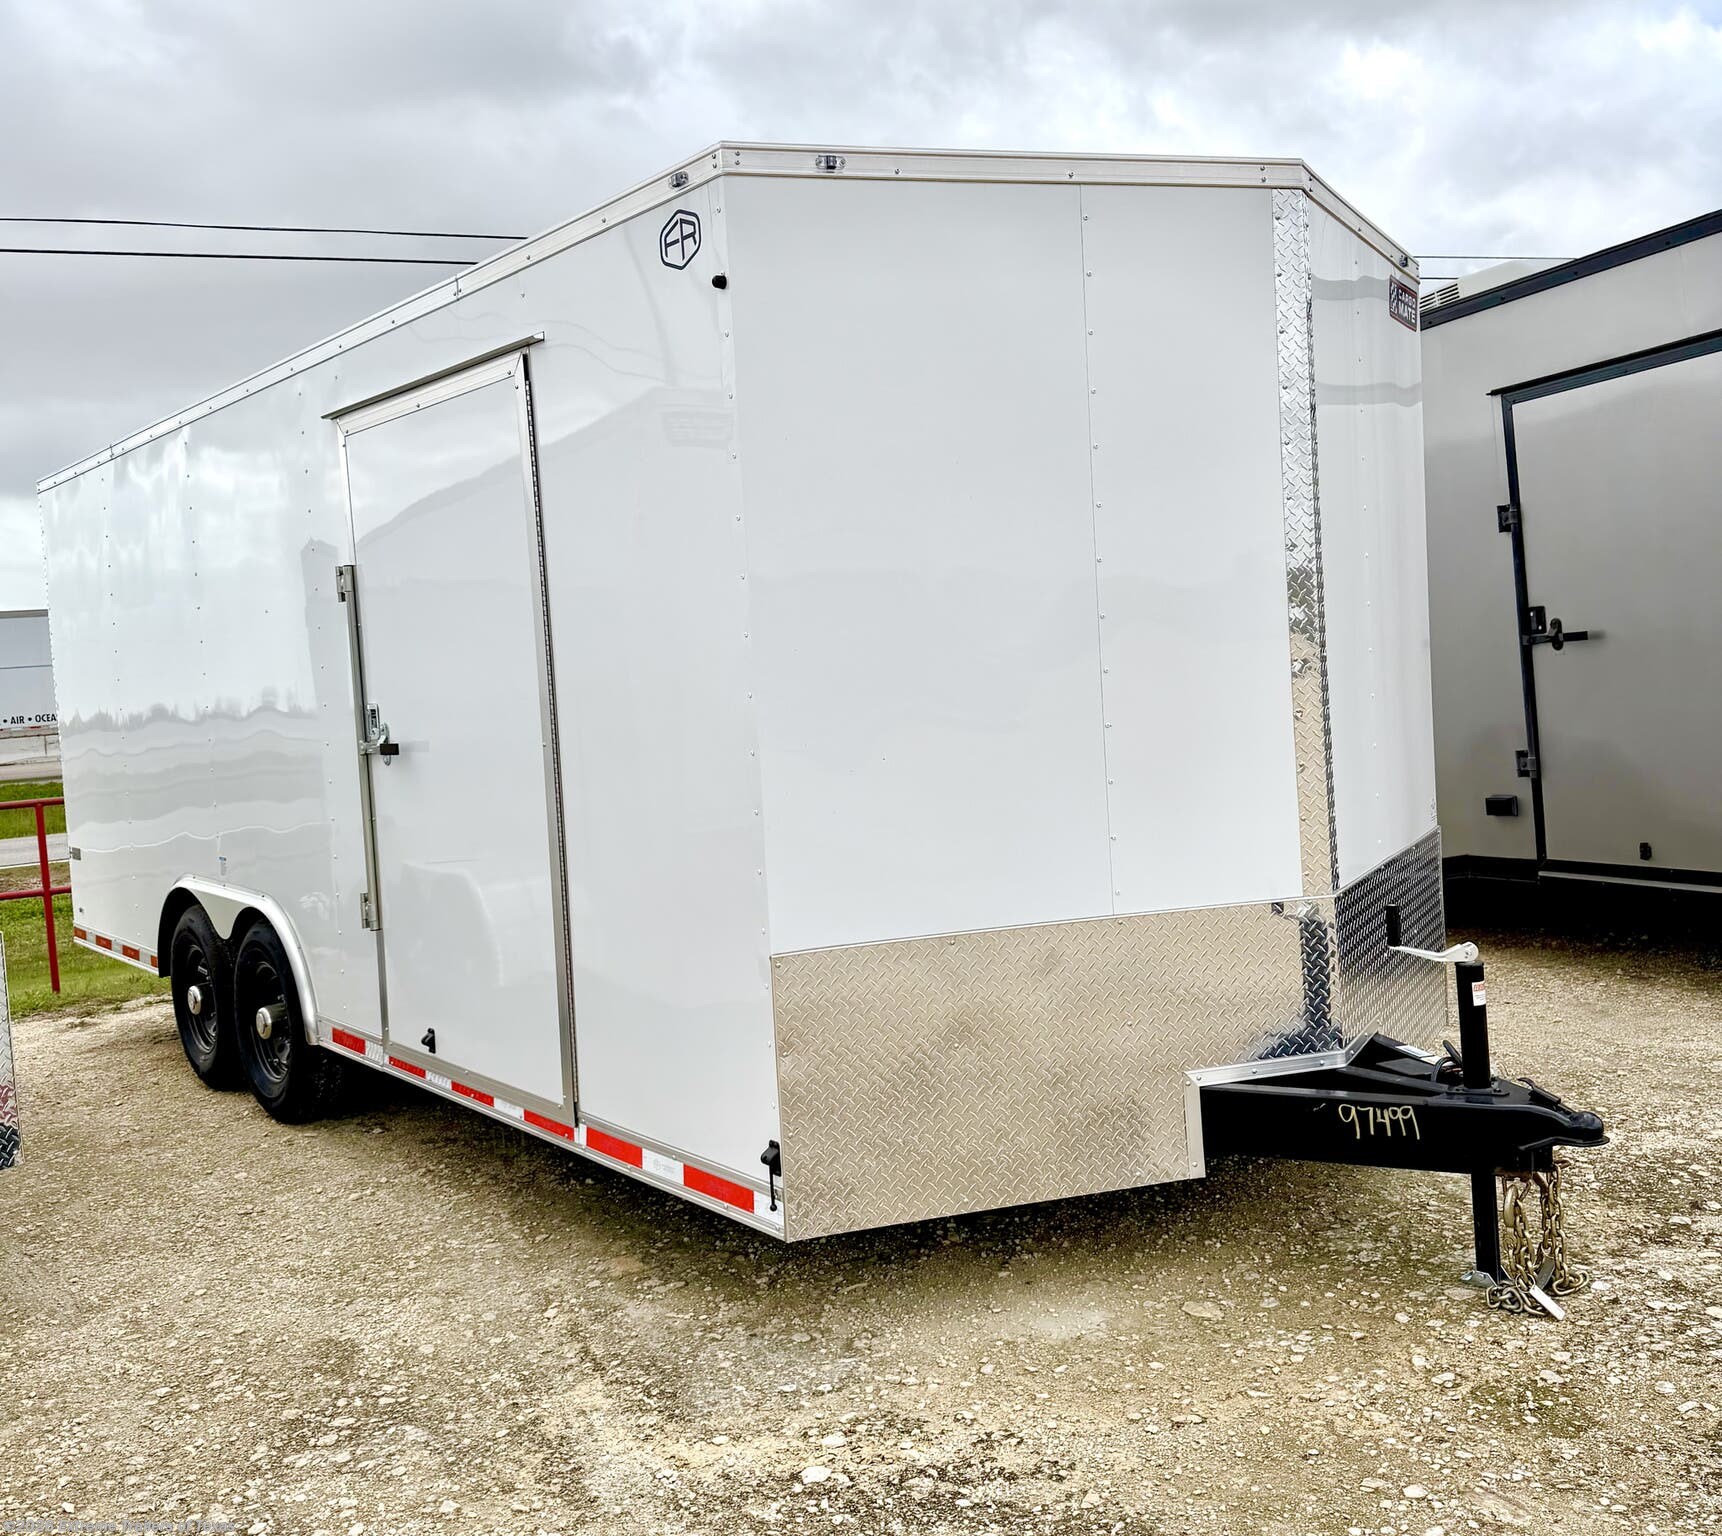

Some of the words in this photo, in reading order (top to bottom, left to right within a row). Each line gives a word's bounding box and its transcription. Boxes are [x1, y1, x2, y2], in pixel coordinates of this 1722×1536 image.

[1398, 301, 1416, 324] MATE
[10, 716, 25, 724] AIR
[34, 713, 57, 723] OCEA
[1338, 1103, 1420, 1140] 97499
